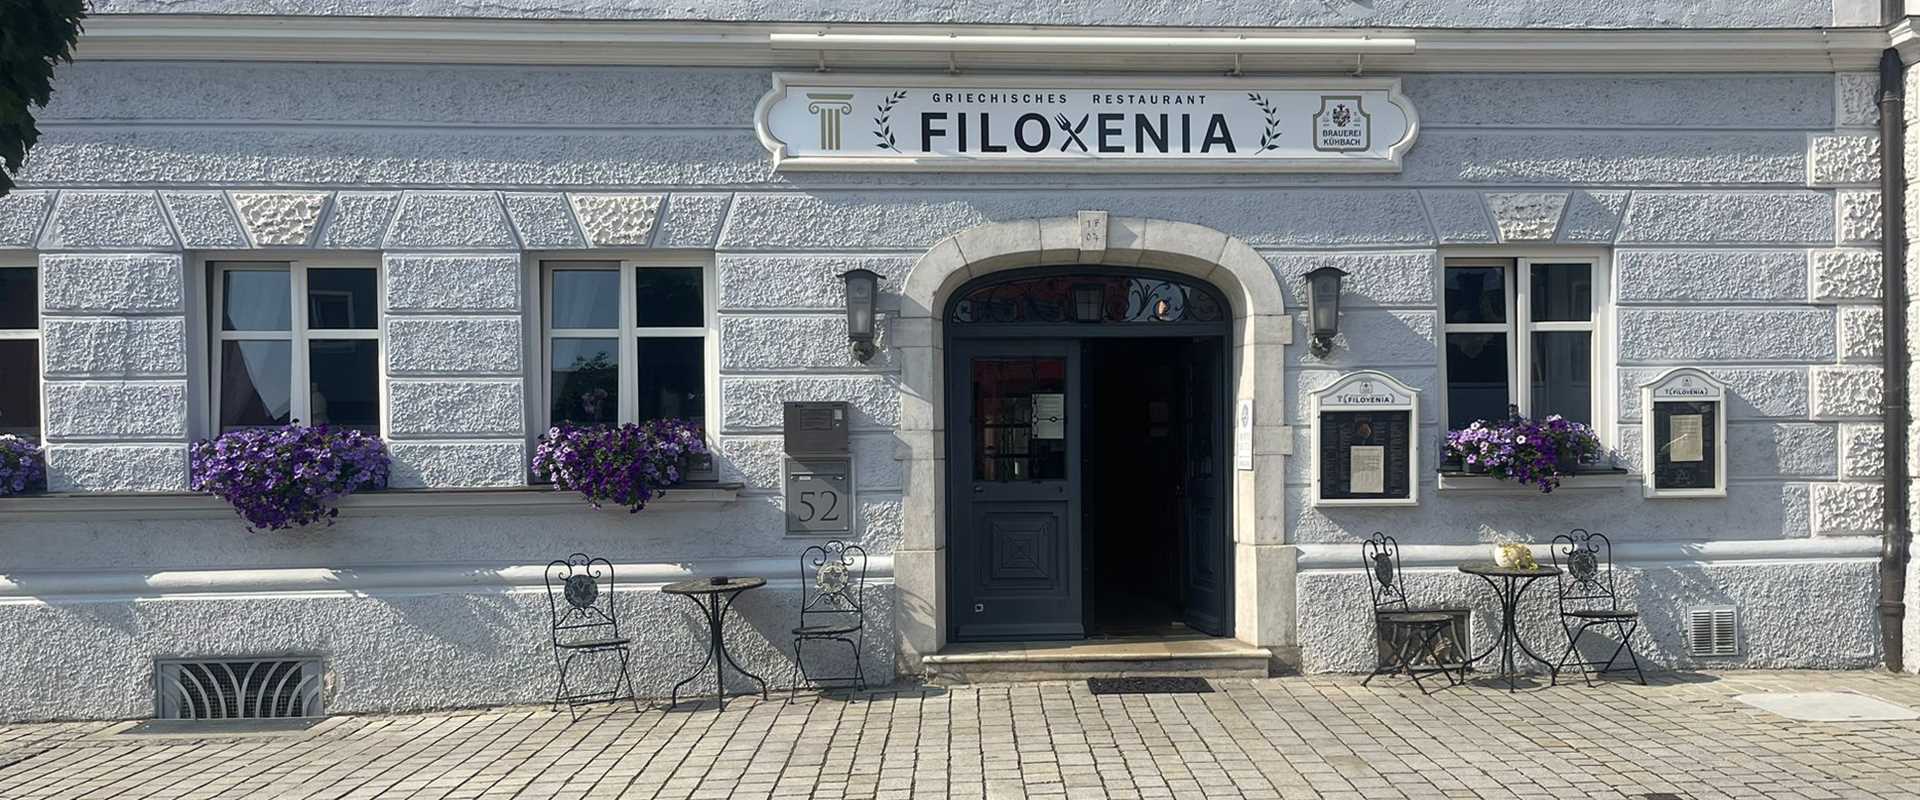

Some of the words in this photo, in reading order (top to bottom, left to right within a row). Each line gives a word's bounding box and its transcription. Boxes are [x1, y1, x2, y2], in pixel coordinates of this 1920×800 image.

[932, 93, 1067, 104] GRIECHISCHES
[1092, 94, 1206, 105] RESTAURANT
[920, 112, 1237, 154] FILOXENIA
[1322, 129, 1362, 137] BRAUEREI
[1323, 138, 1361, 146] KÜHBACH
[798, 490, 840, 522] 52
